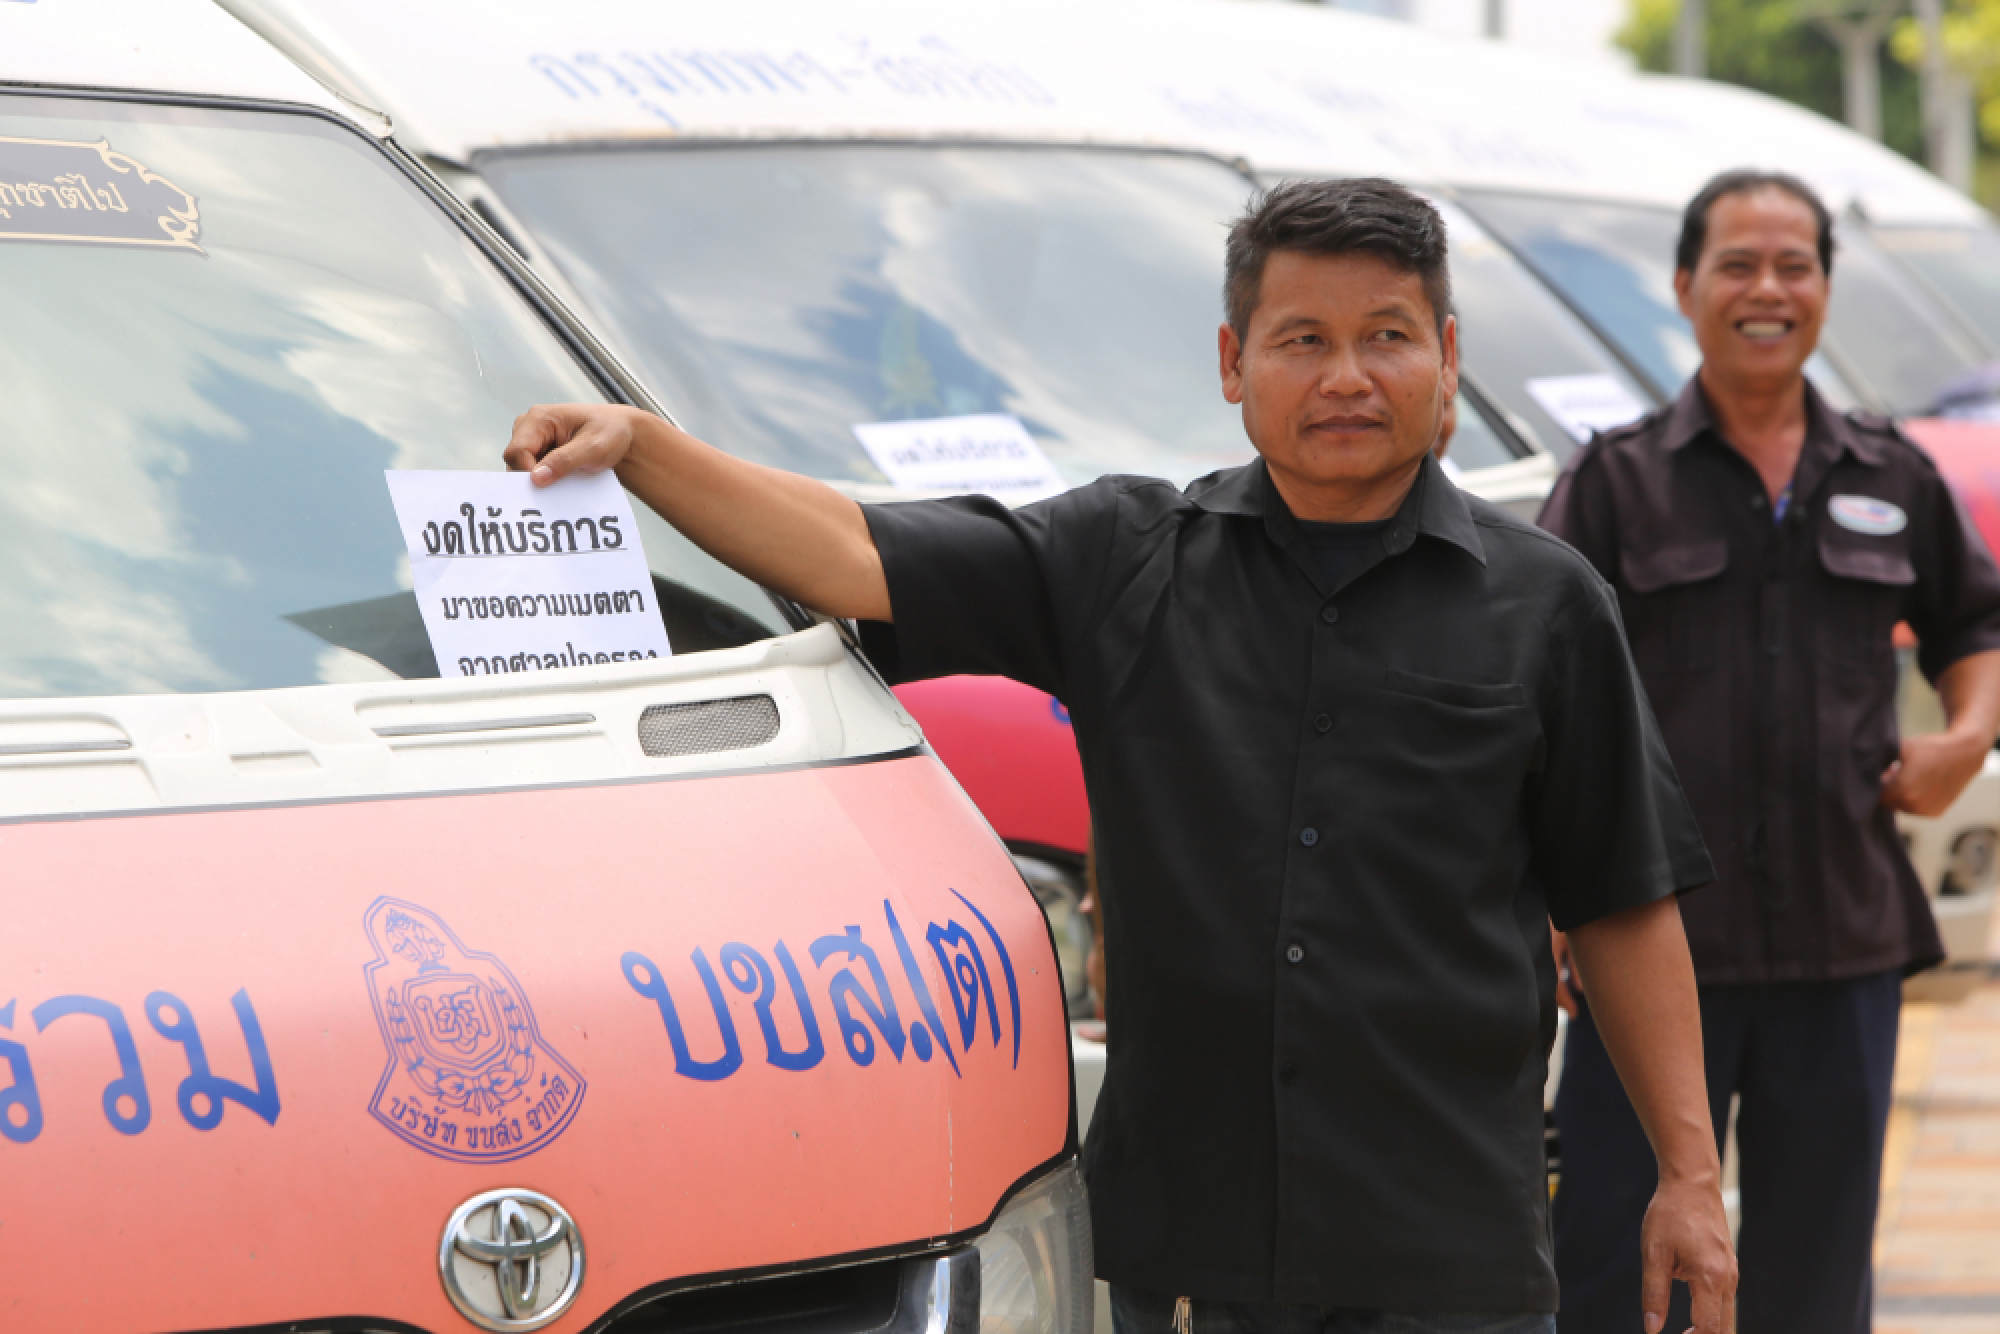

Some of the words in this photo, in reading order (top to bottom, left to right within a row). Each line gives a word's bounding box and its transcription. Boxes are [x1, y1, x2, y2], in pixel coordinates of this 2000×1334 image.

[0, 172, 129, 218] ุกชาติไป
[422, 502, 624, 555] งดให้บริการ
[441, 589, 646, 620] มาขอความเมตตา
[390, 1096, 459, 1145] บริษัท
[465, 1110, 523, 1149] ขนส่ง
[526, 1072, 570, 1131] จำกัด
